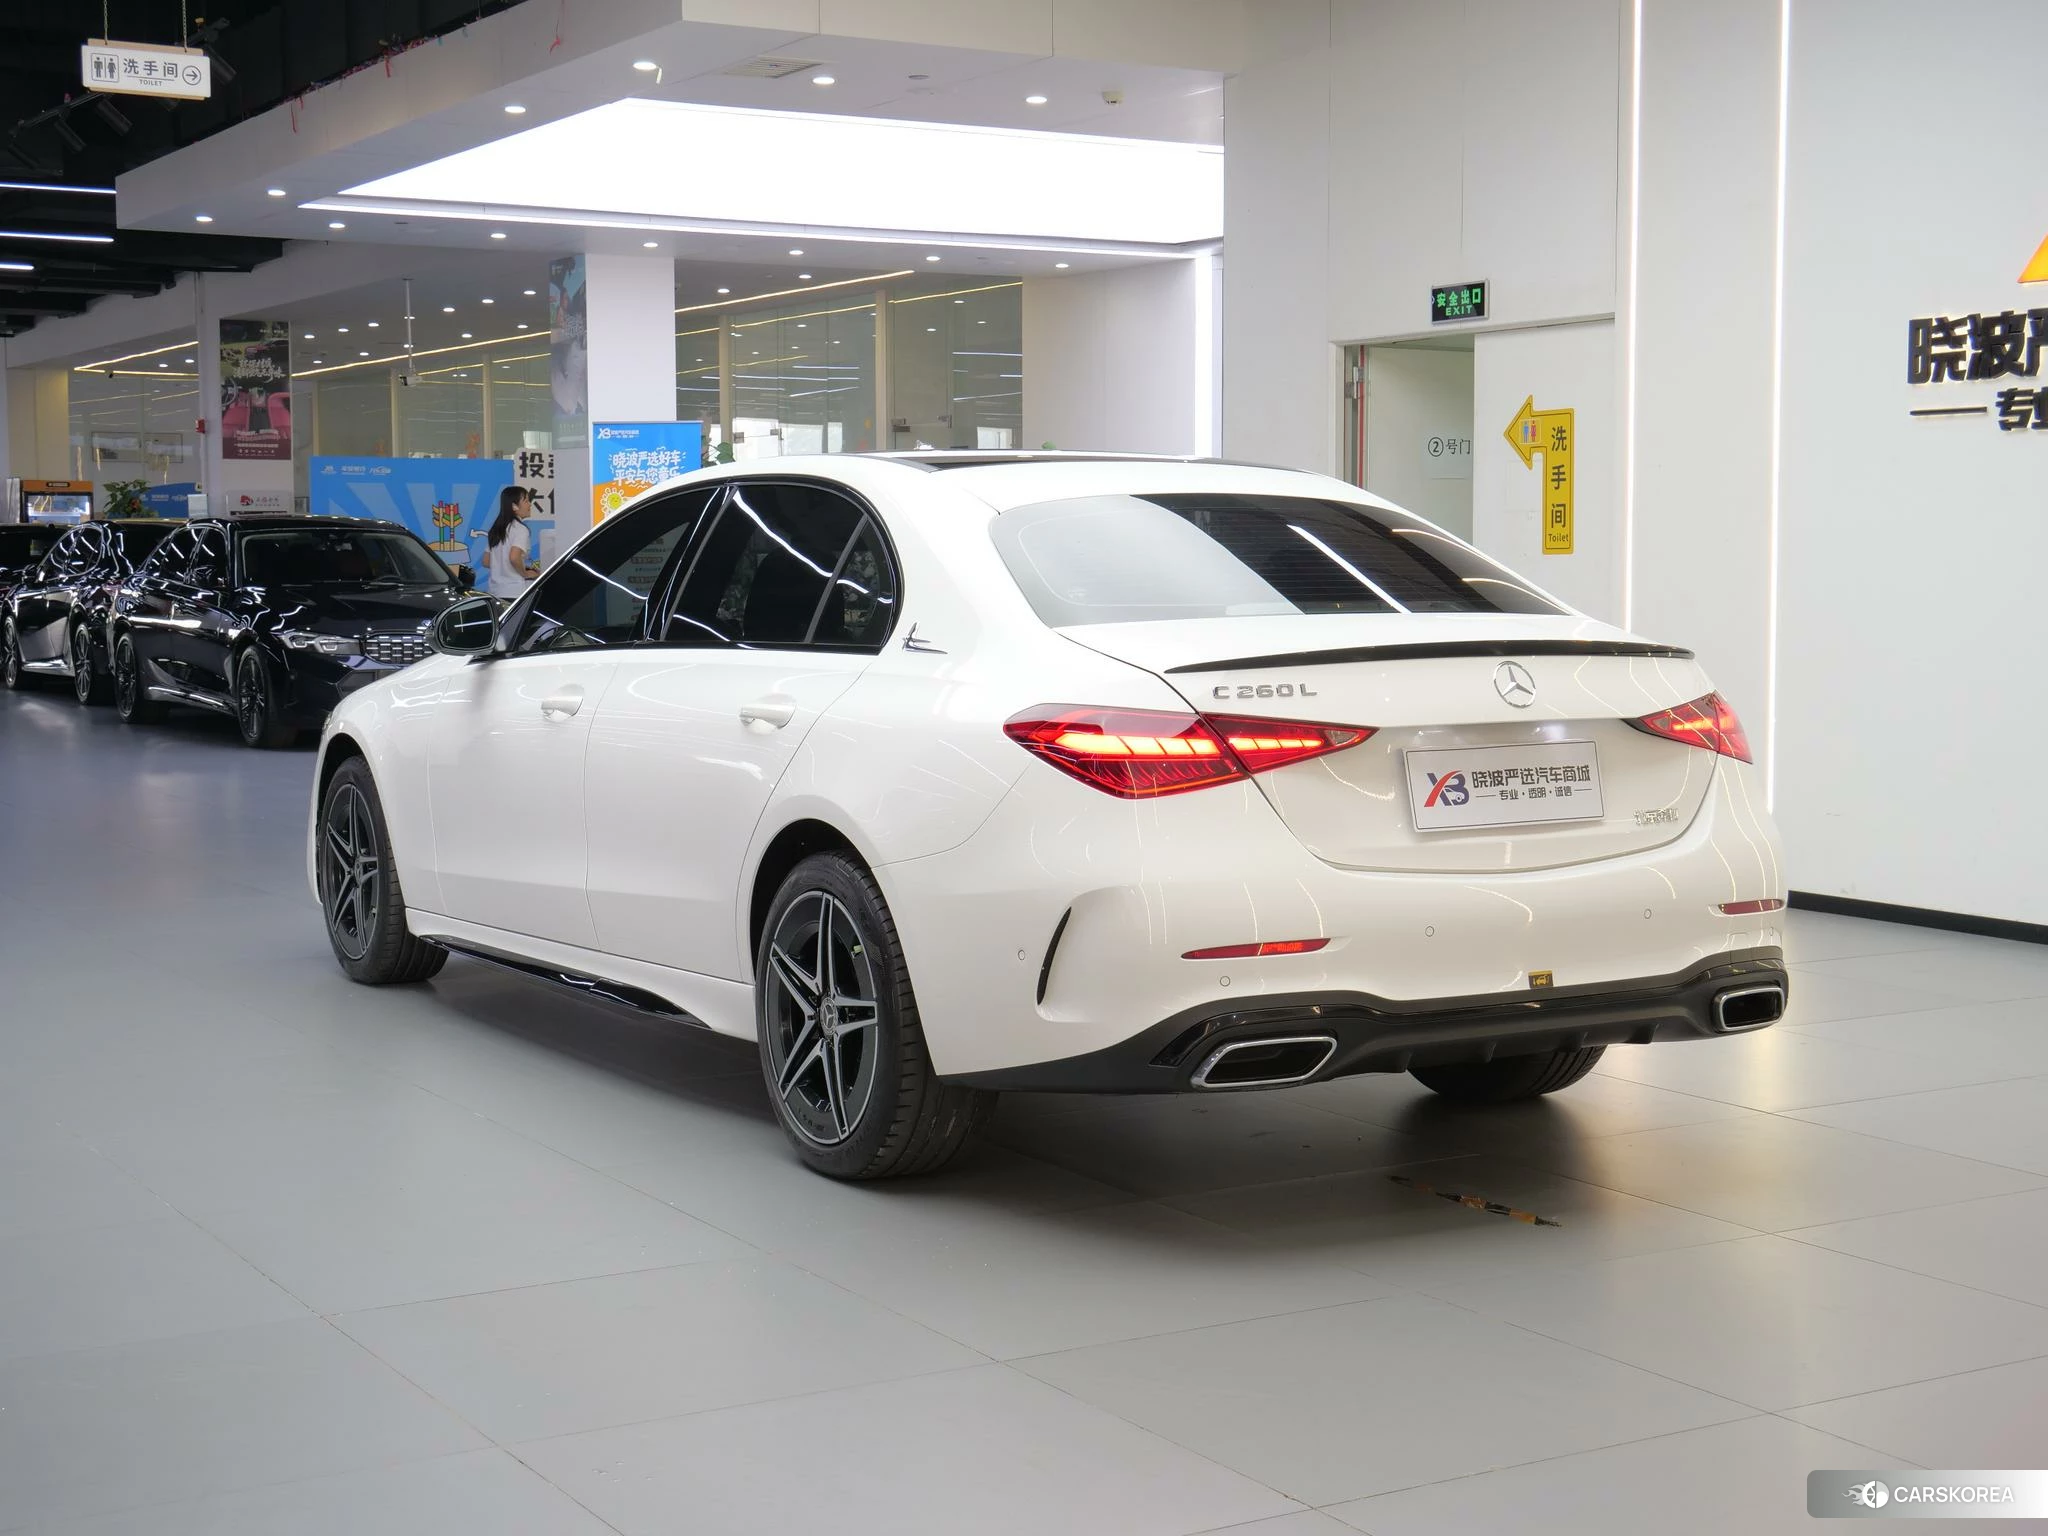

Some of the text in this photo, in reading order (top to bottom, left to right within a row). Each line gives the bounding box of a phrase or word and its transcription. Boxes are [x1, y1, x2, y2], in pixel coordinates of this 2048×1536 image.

[123, 58, 178, 78] 洗手间
[139, 79, 163, 87] TOILET
[1437, 287, 1482, 308] 安全出口
[1445, 304, 1473, 316] EXIT
[1551, 425, 1568, 529] 洗手间
[1548, 533, 1569, 543] Toilet
[1471, 764, 1592, 789] 晓波严选汽车商城
